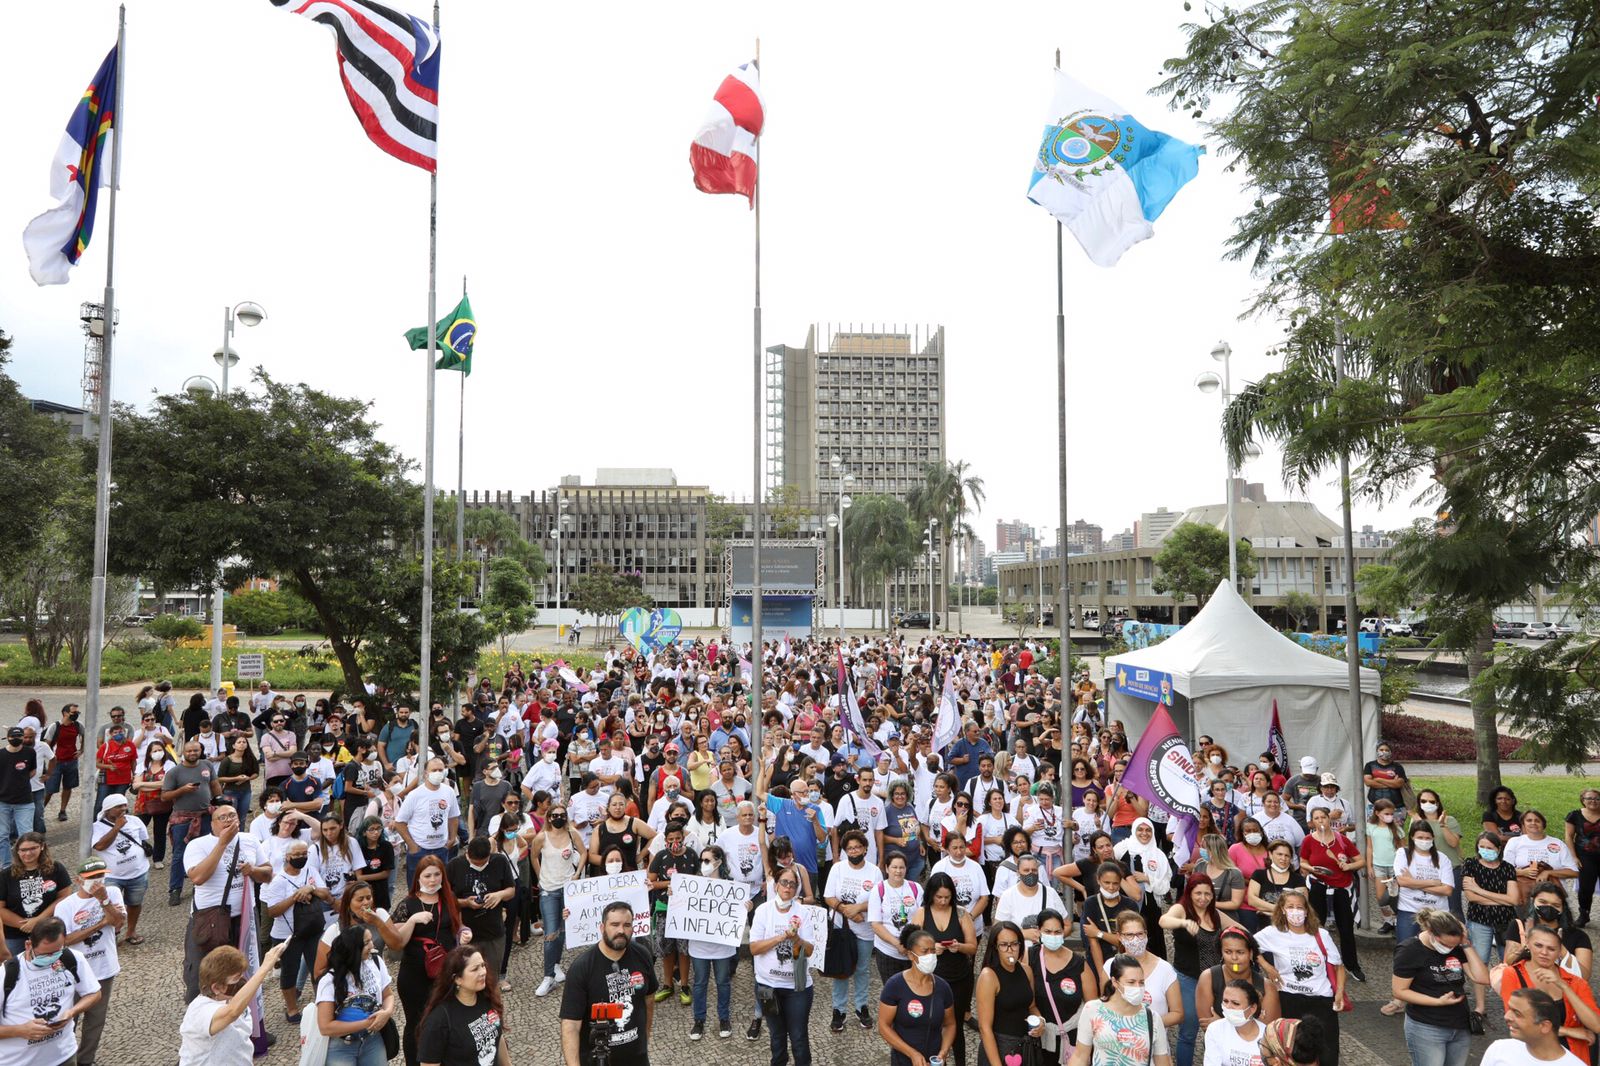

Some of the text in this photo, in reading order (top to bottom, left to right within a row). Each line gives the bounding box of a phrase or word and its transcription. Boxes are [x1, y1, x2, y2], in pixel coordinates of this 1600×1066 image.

[1149, 759, 1166, 797] RESPEITO
[1164, 796, 1173, 804] E
[566, 874, 639, 897] QUEM DERA
[632, 921, 649, 935] ÇÃO
[668, 916, 743, 939] A INFLAÇÃO
[1286, 983, 1314, 993] SINDSERV
[30, 997, 43, 1007] DO
